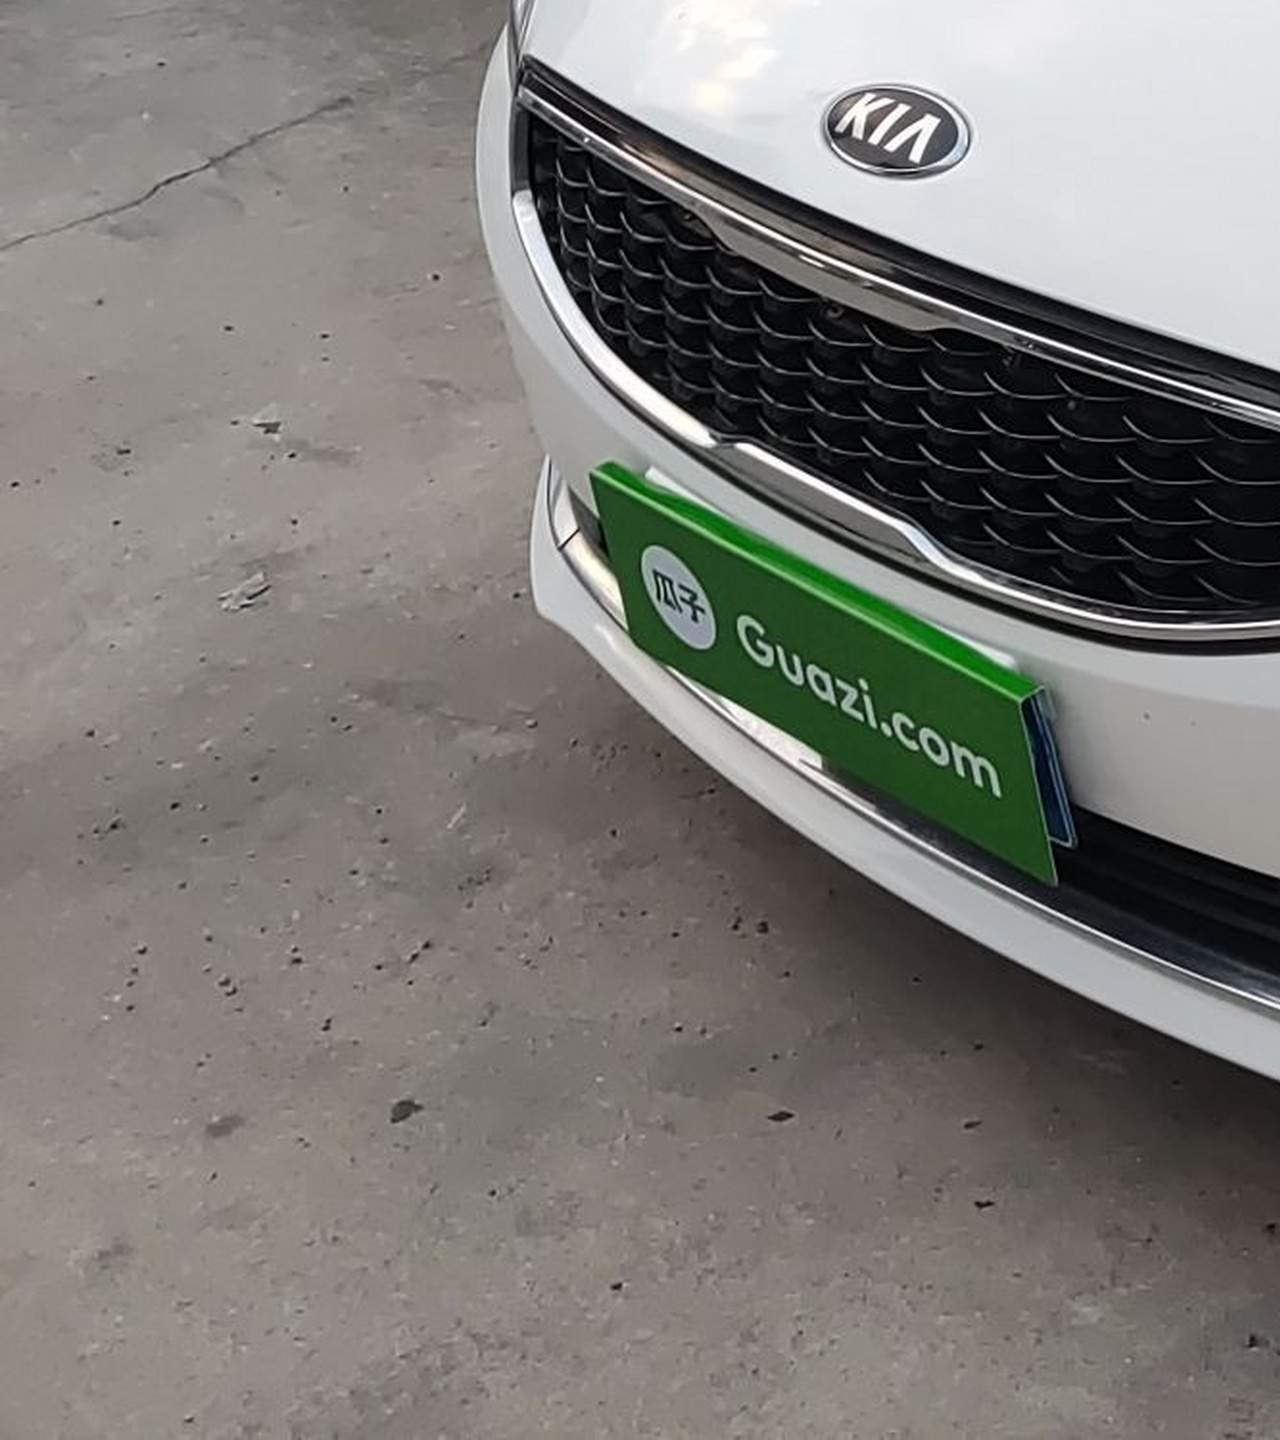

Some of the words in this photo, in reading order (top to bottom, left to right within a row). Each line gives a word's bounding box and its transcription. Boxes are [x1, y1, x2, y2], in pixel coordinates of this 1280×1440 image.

[834, 92, 941, 164] KIA
[652, 569, 706, 624] 瓜子
[736, 614, 1003, 799] Guazi.com
